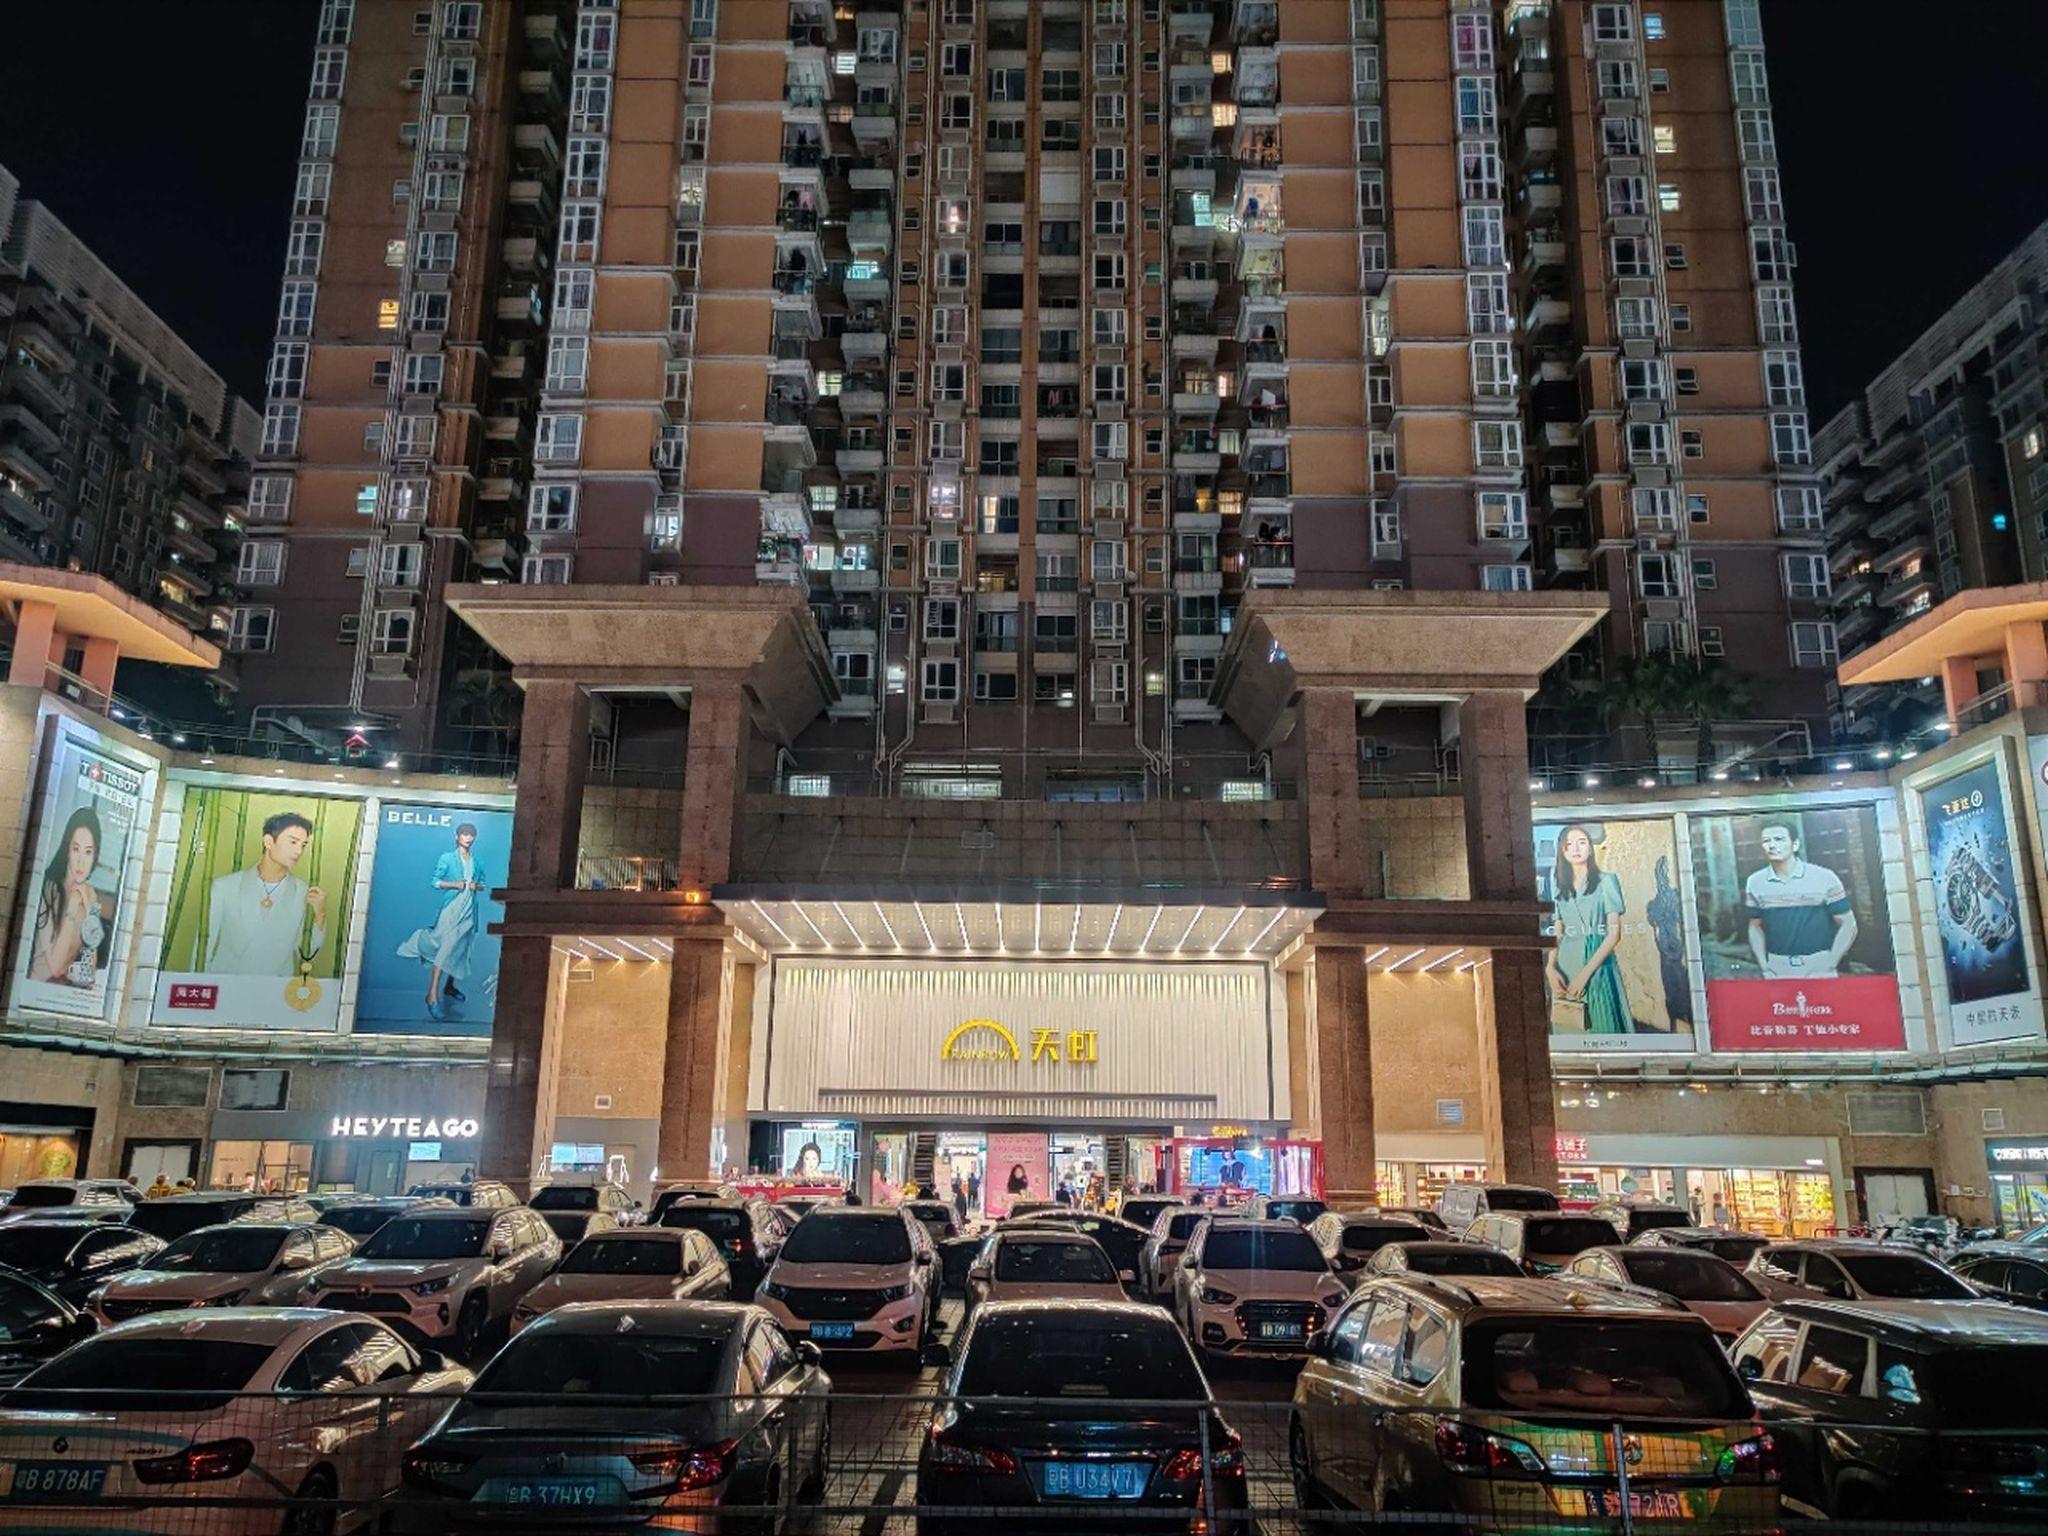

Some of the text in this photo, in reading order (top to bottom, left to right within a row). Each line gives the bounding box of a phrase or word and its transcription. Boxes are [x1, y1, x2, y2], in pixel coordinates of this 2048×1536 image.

[103, 770, 138, 794] TISSOT
[387, 811, 452, 826] BELLE
[1030, 1027, 1098, 1063] 天虹
[331, 1116, 479, 1137] HEYTEAGO
